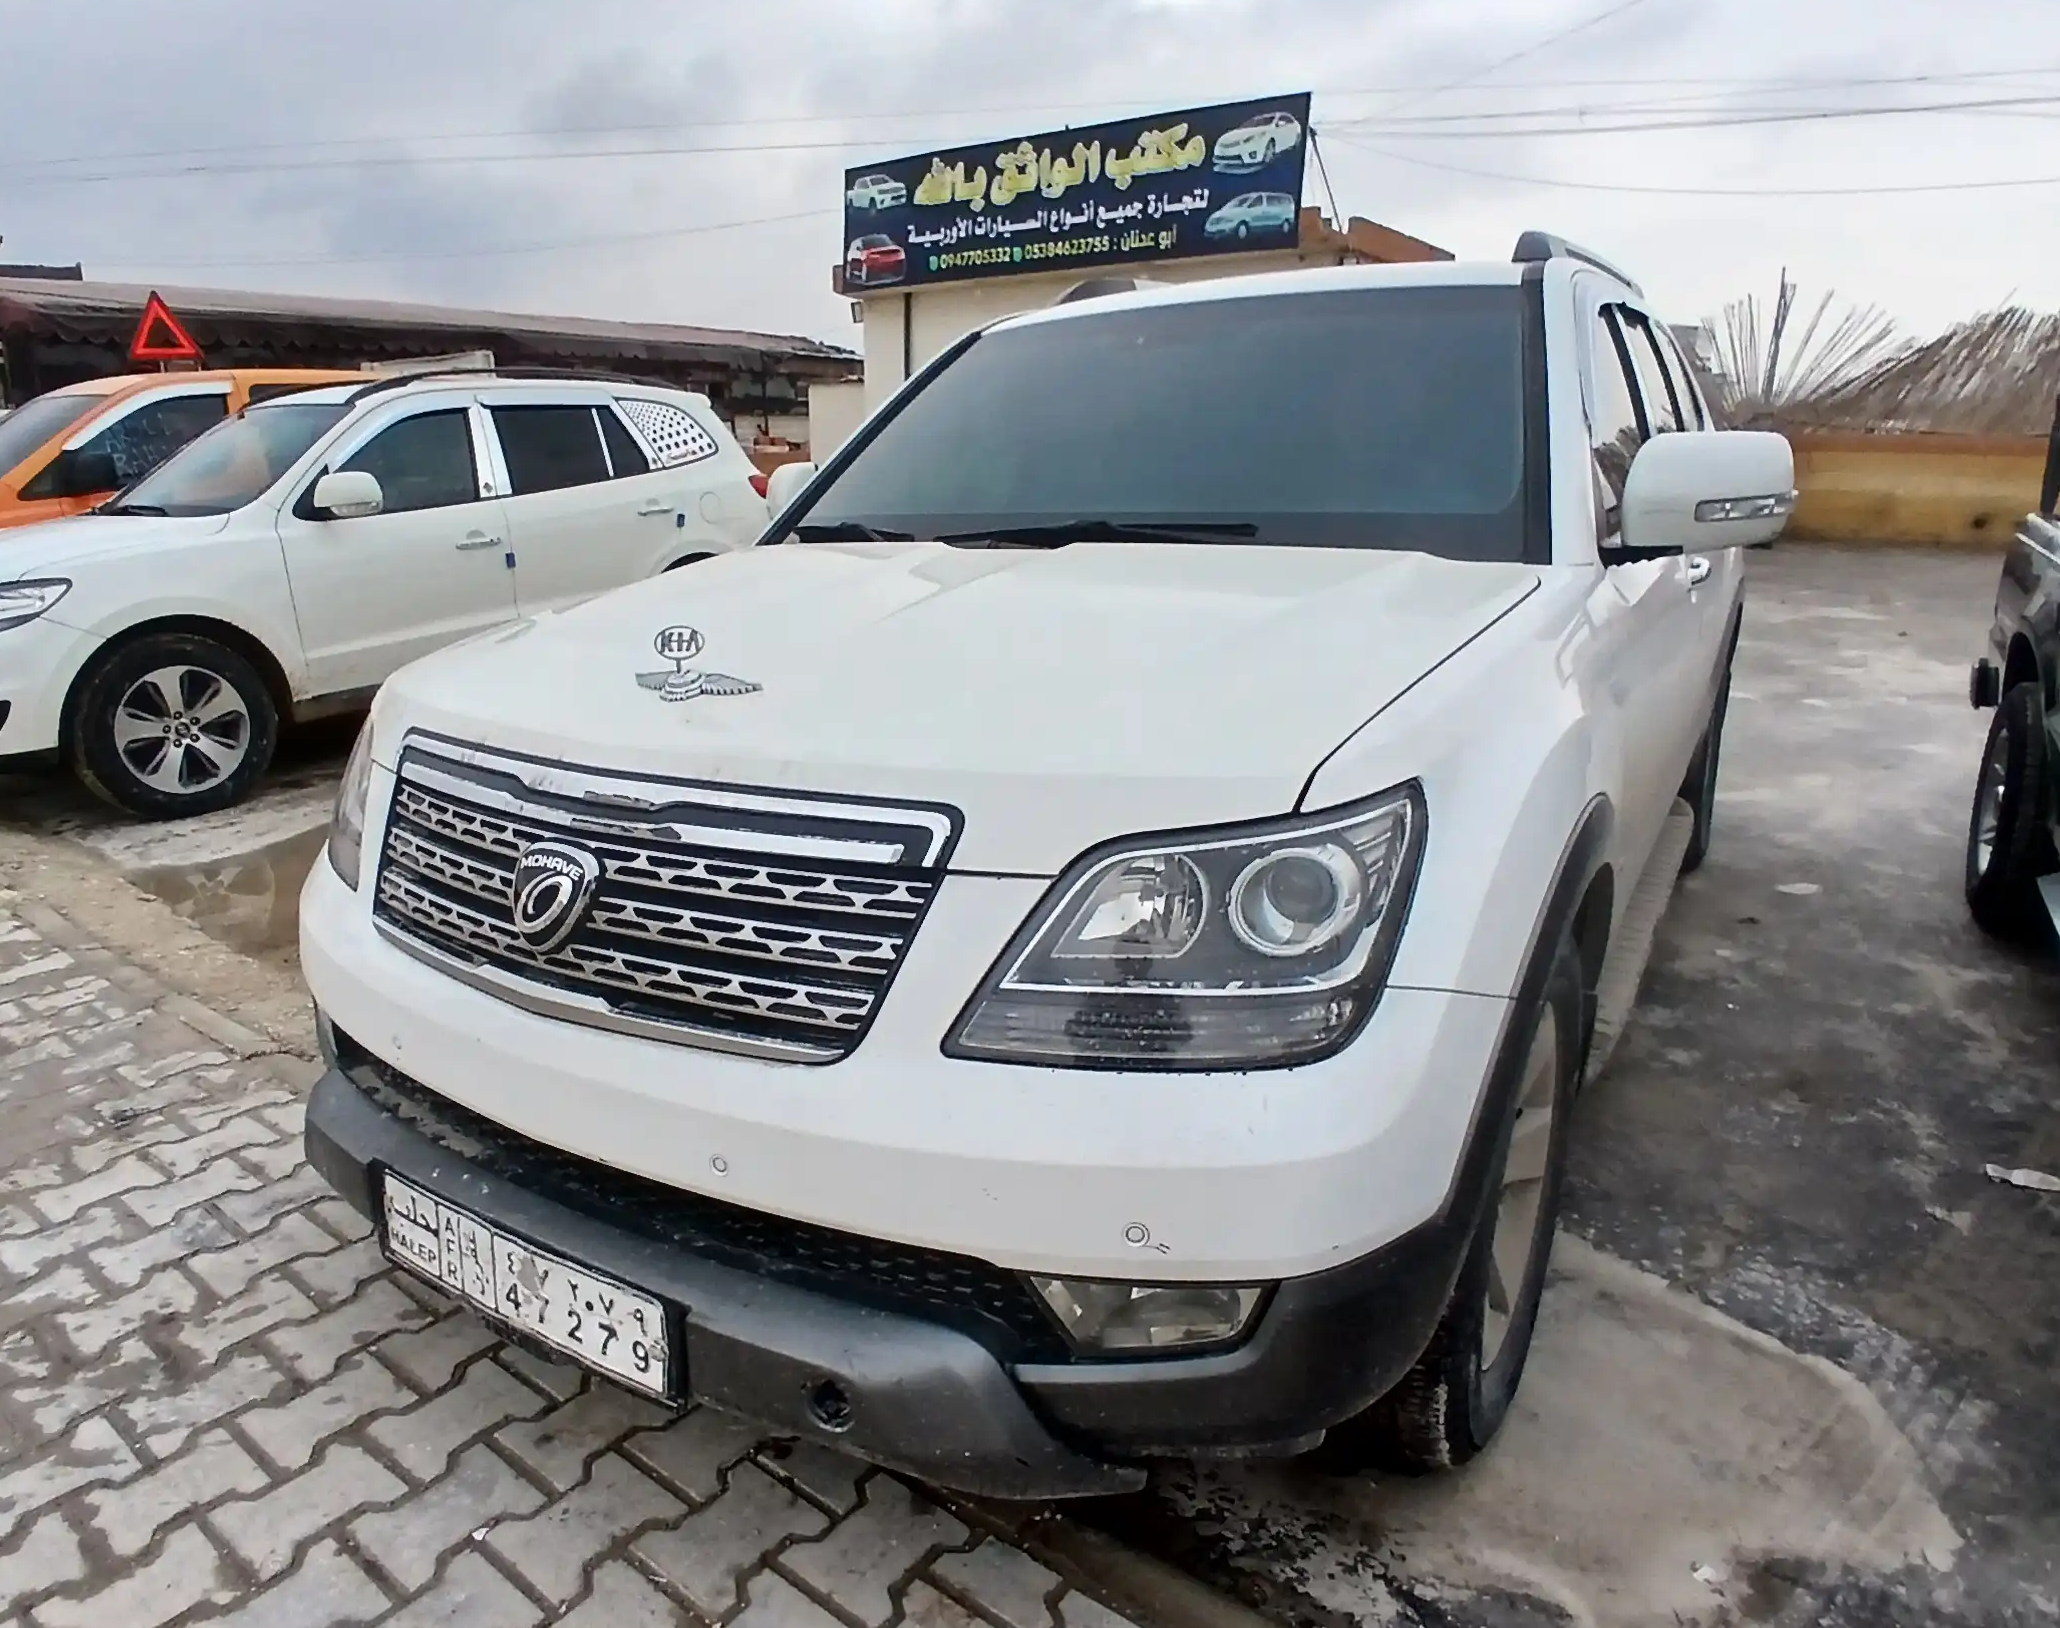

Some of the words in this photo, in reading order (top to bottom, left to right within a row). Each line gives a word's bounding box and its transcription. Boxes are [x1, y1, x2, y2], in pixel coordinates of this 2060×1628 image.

[1105, 122, 1206, 191] مكتب
[990, 140, 1101, 206] الواثق
[1096, 201, 1143, 229] جميع
[1147, 188, 1210, 219] لتجارة
[974, 209, 1048, 238] السيارات
[1120, 229, 1155, 251] عدنان
[939, 246, 1011, 270] 0947705332
[660, 629, 701, 653] KIA
[520, 854, 584, 881] MOHAVE
[391, 1227, 437, 1263] HALEP
